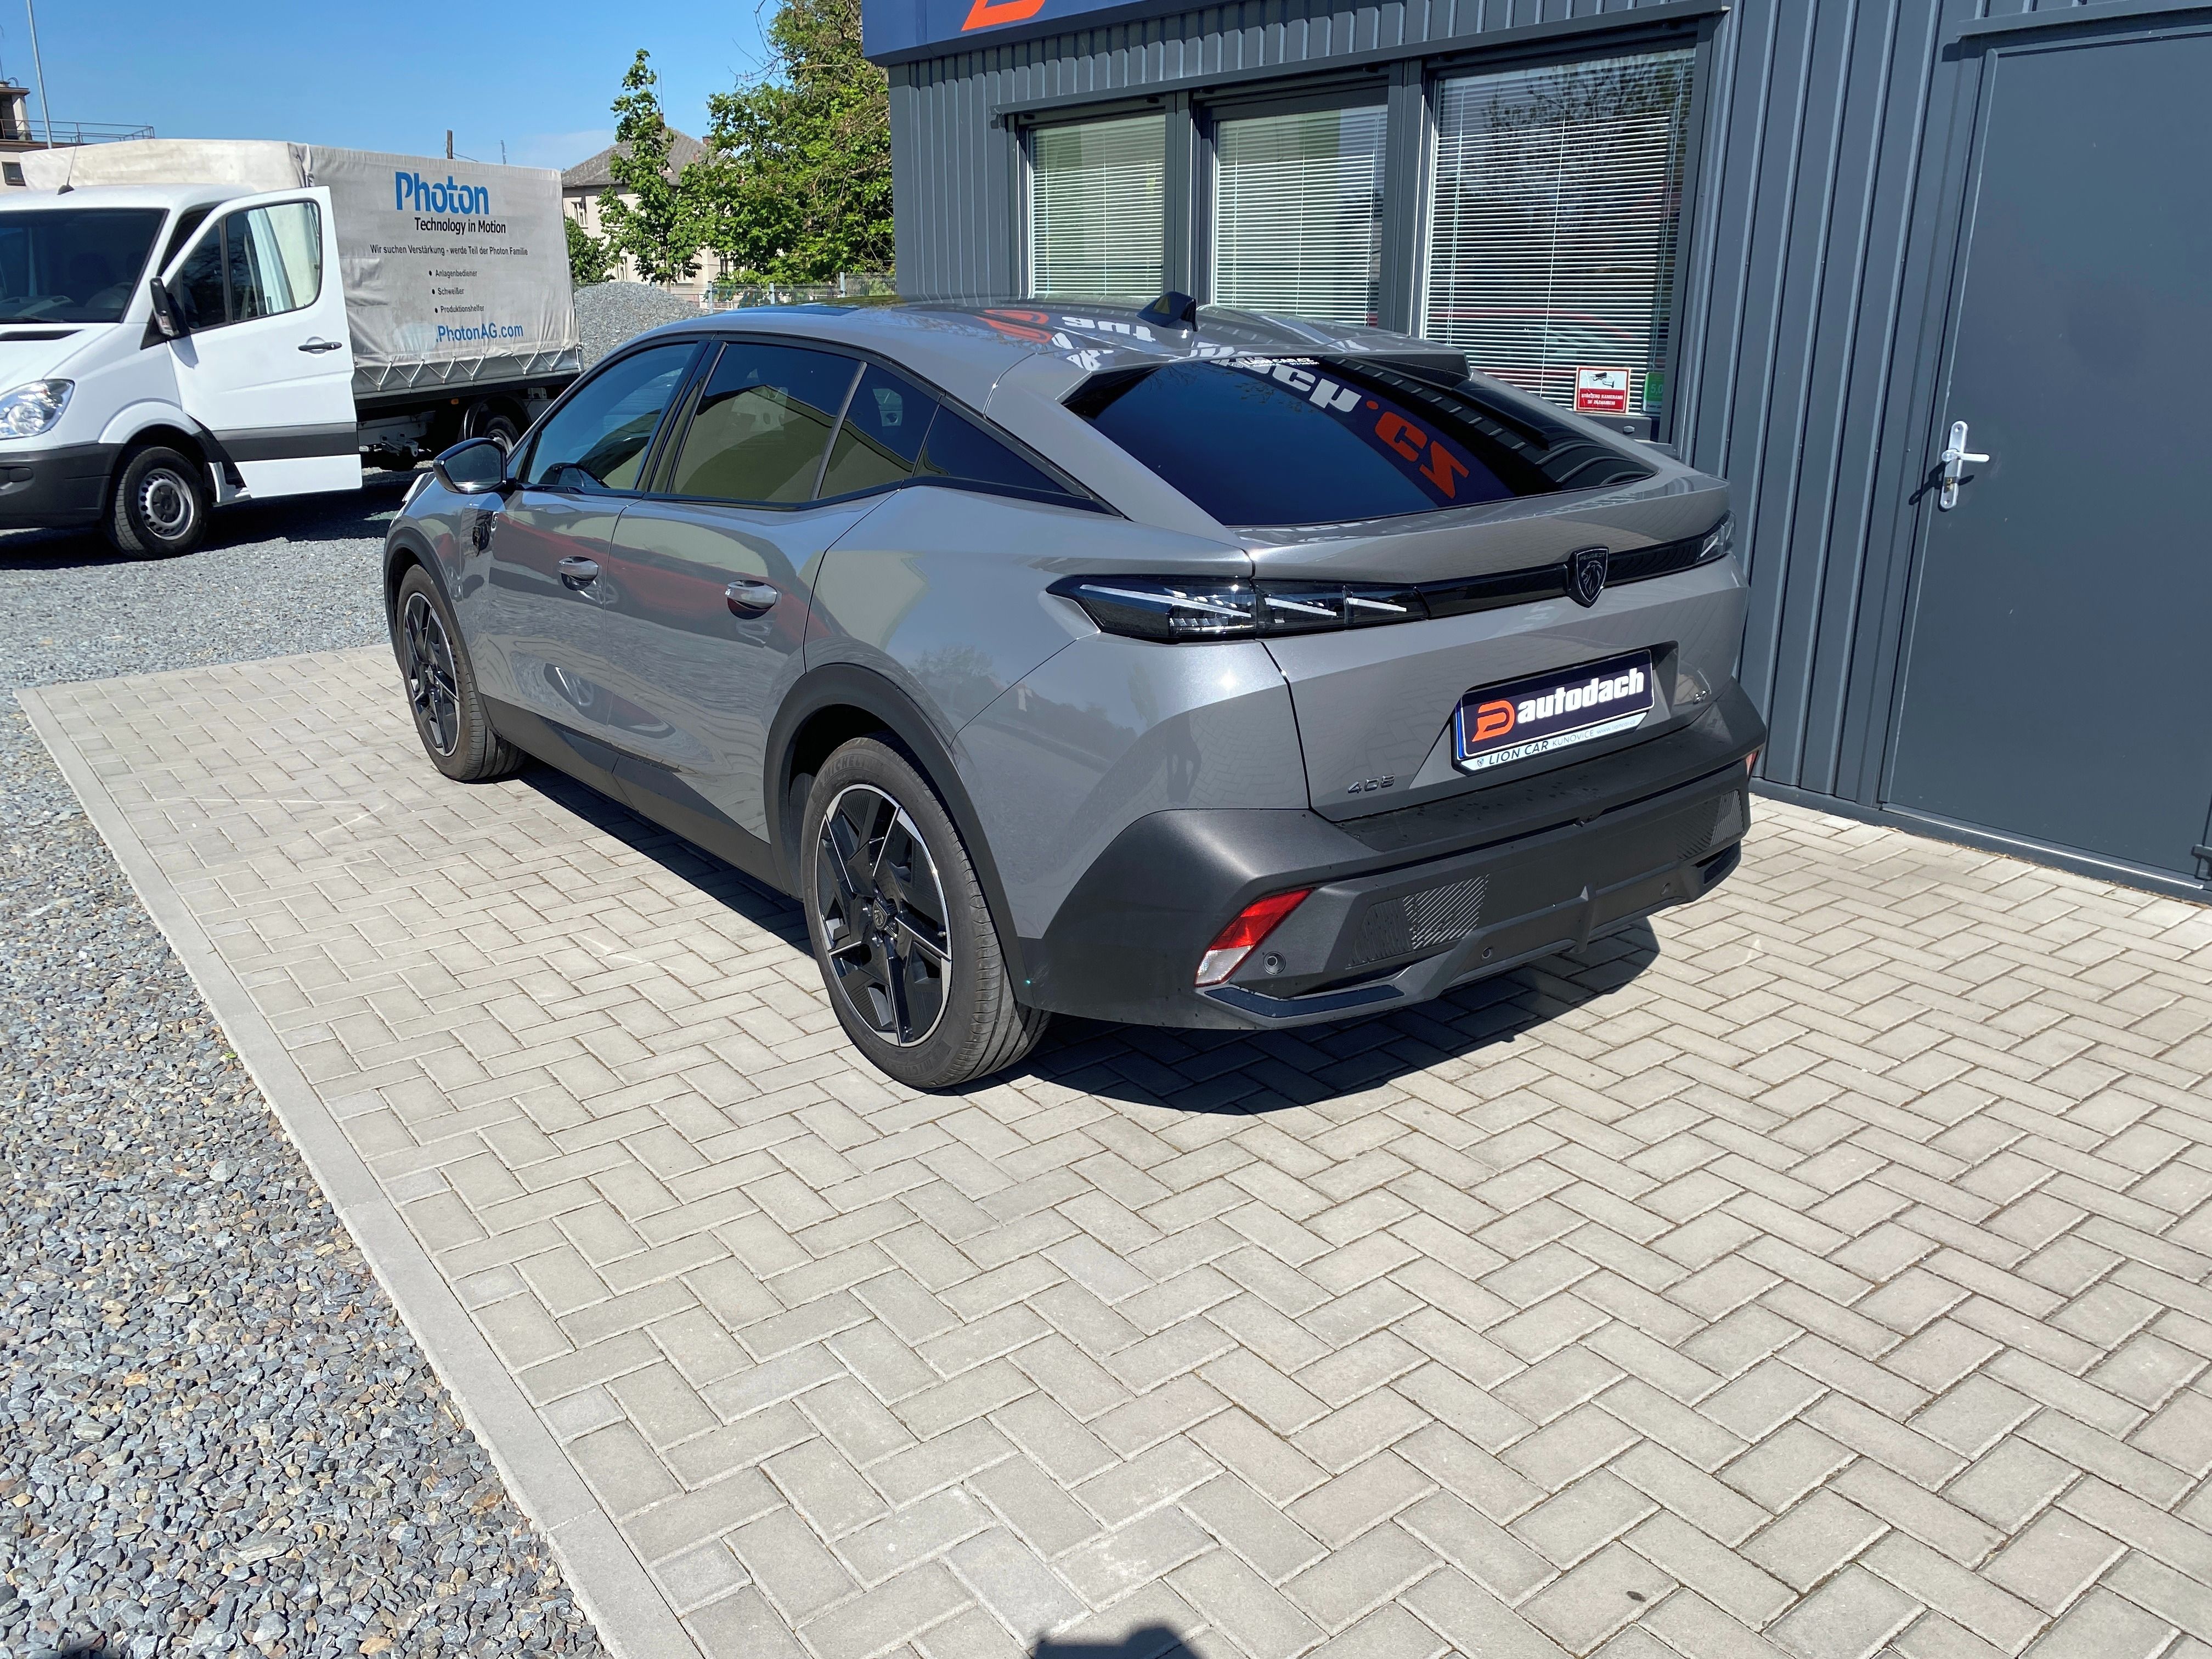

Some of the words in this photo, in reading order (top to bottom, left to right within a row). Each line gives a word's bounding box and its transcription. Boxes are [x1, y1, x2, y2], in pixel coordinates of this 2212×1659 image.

[395, 171, 489, 215] Photon
[415, 217, 465, 235] Technology
[469, 219, 476, 233] in
[478, 220, 506, 233] Motion
[370, 245, 381, 253] Wir
[383, 245, 407, 253] suchen
[408, 245, 445, 256] Verstärkung
[449, 246, 467, 255] werde
[469, 246, 478, 255] Teil
[435, 269, 477, 279] Anlagenbediener
[437, 287, 464, 296] Schweißer
[440, 304, 484, 314] Produktionshelfer
[1579, 552, 1605, 561] PEUGEOT
[1517, 667, 1645, 724] autodach
[1488, 748, 1520, 765] LION
[1524, 741, 1548, 755] CAR
[1552, 730, 1594, 747] KUNOVICE
[1347, 774, 1396, 794] 408
